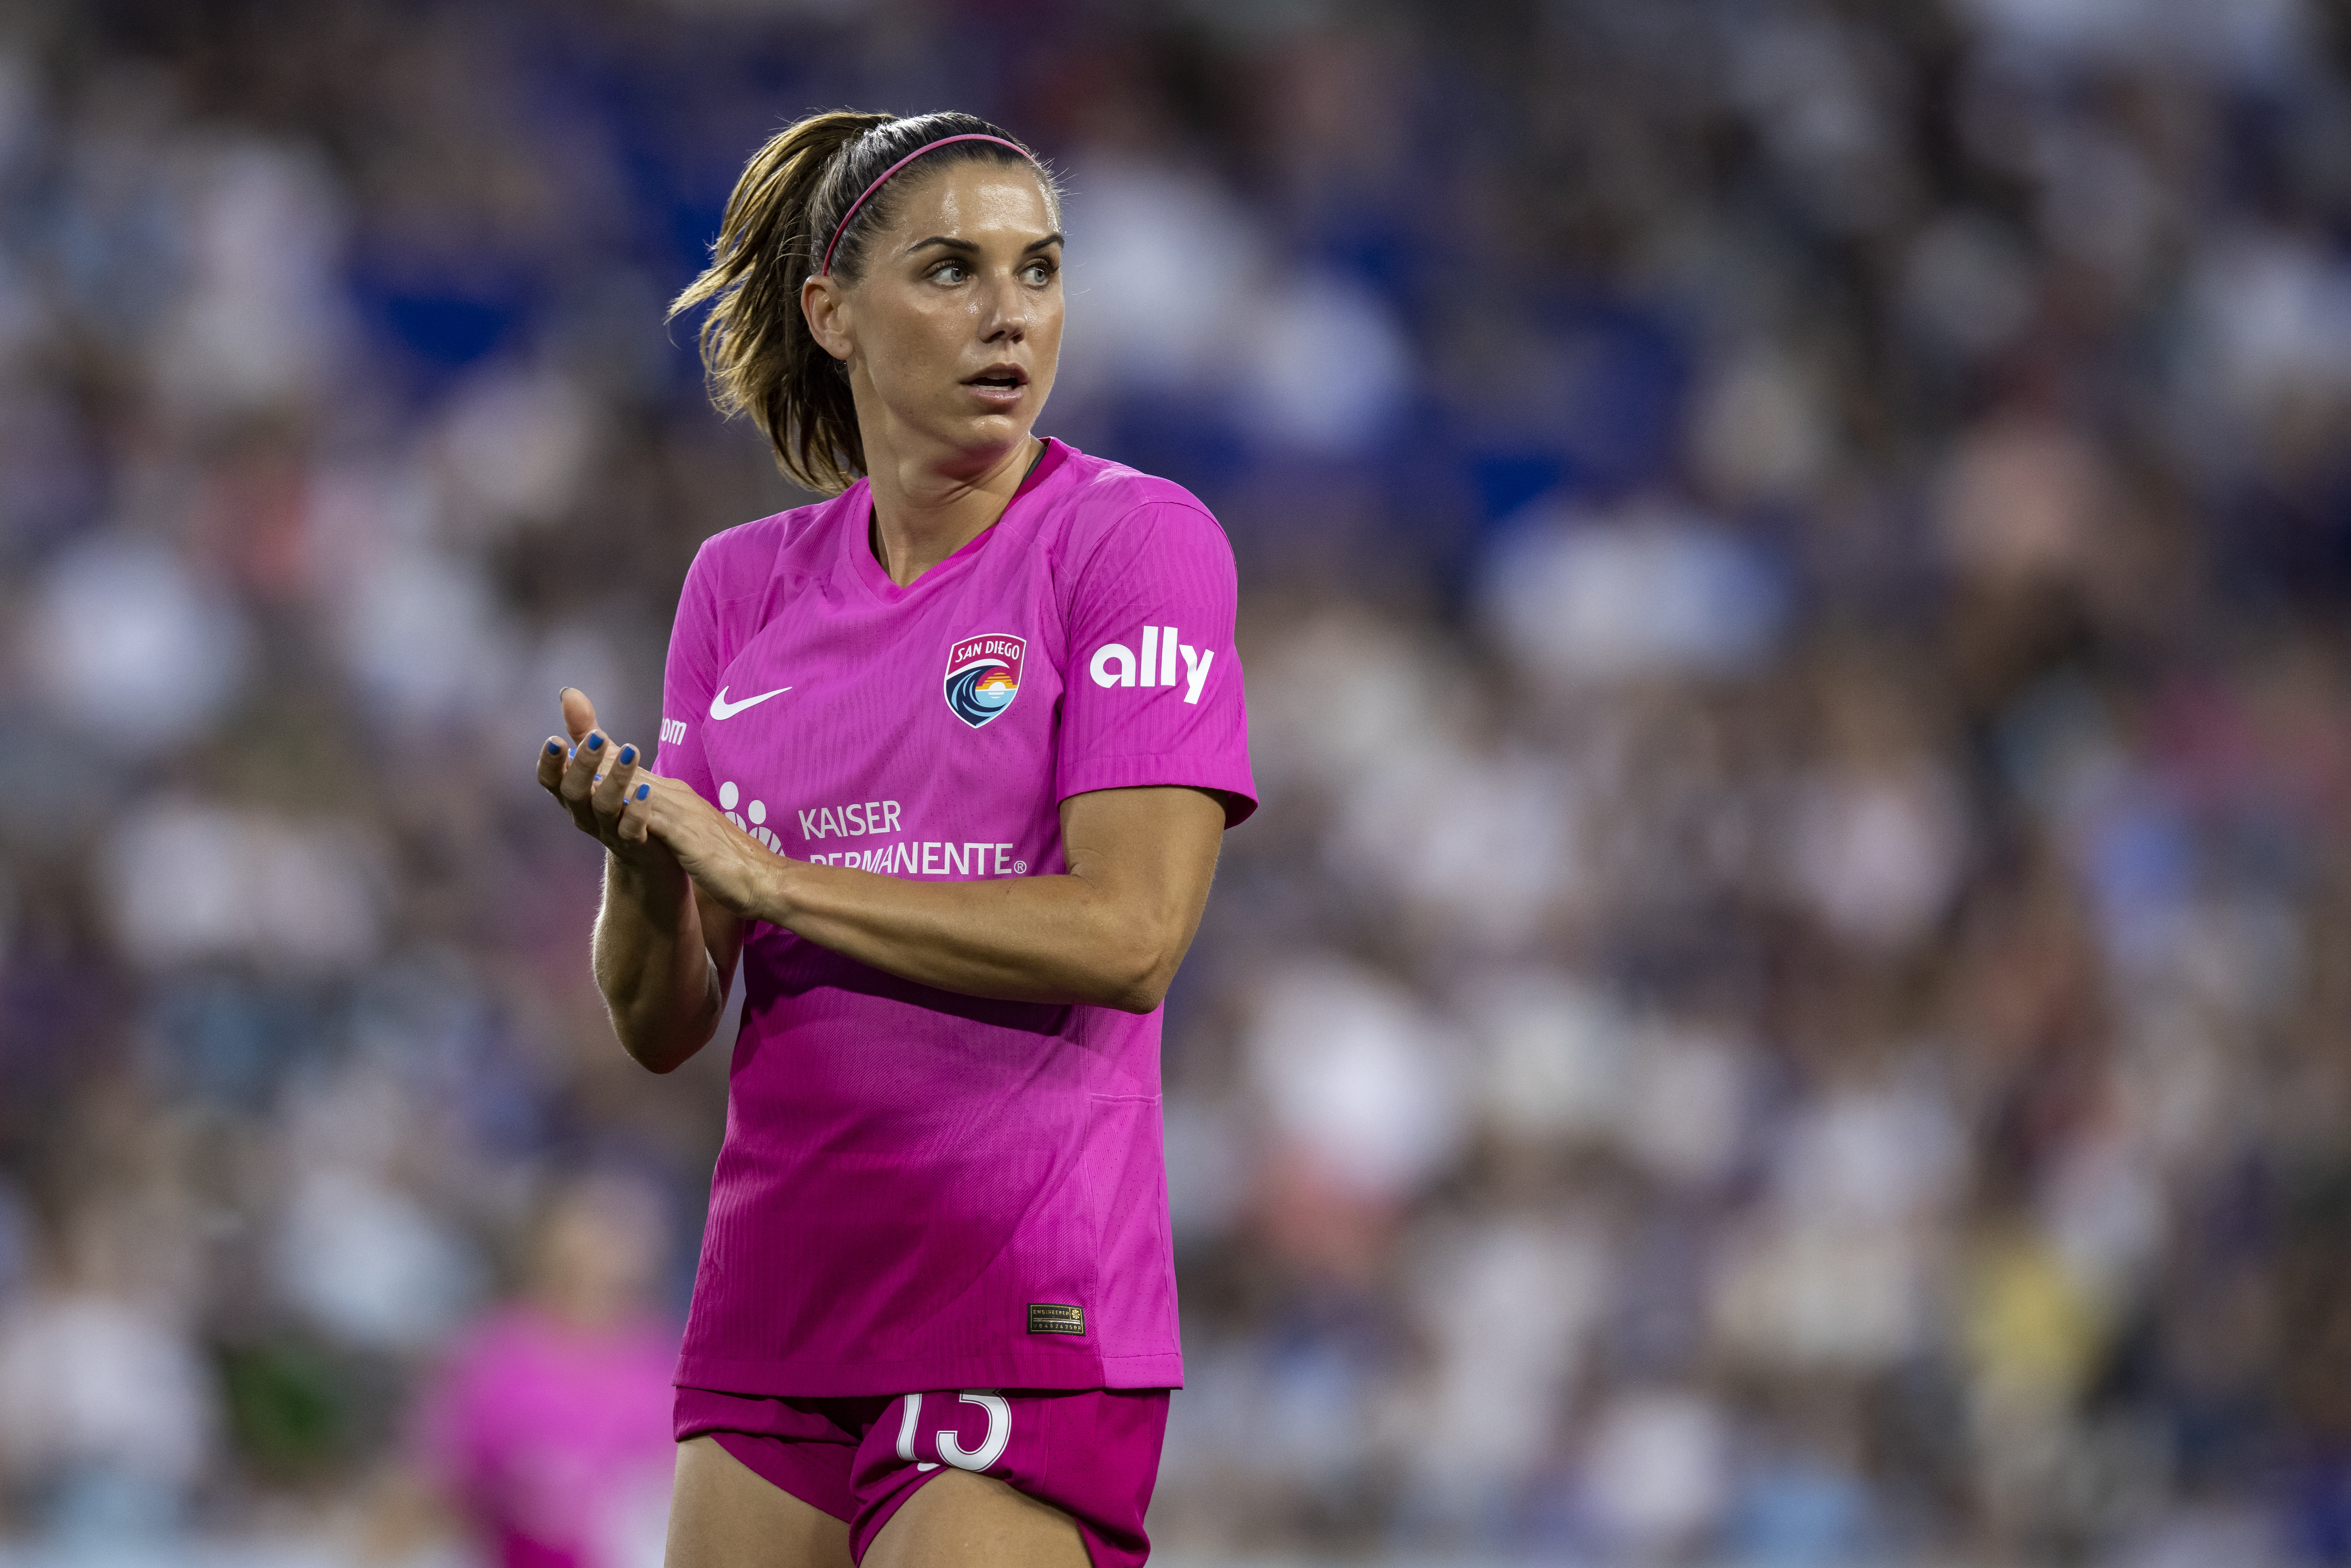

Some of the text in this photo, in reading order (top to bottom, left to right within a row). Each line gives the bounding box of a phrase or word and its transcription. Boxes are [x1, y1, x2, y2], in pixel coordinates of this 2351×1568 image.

[955, 640, 1020, 663] SAN DIEGO
[1090, 625, 1215, 705] ally
[661, 718, 687, 745] om
[798, 800, 901, 840] KAISER
